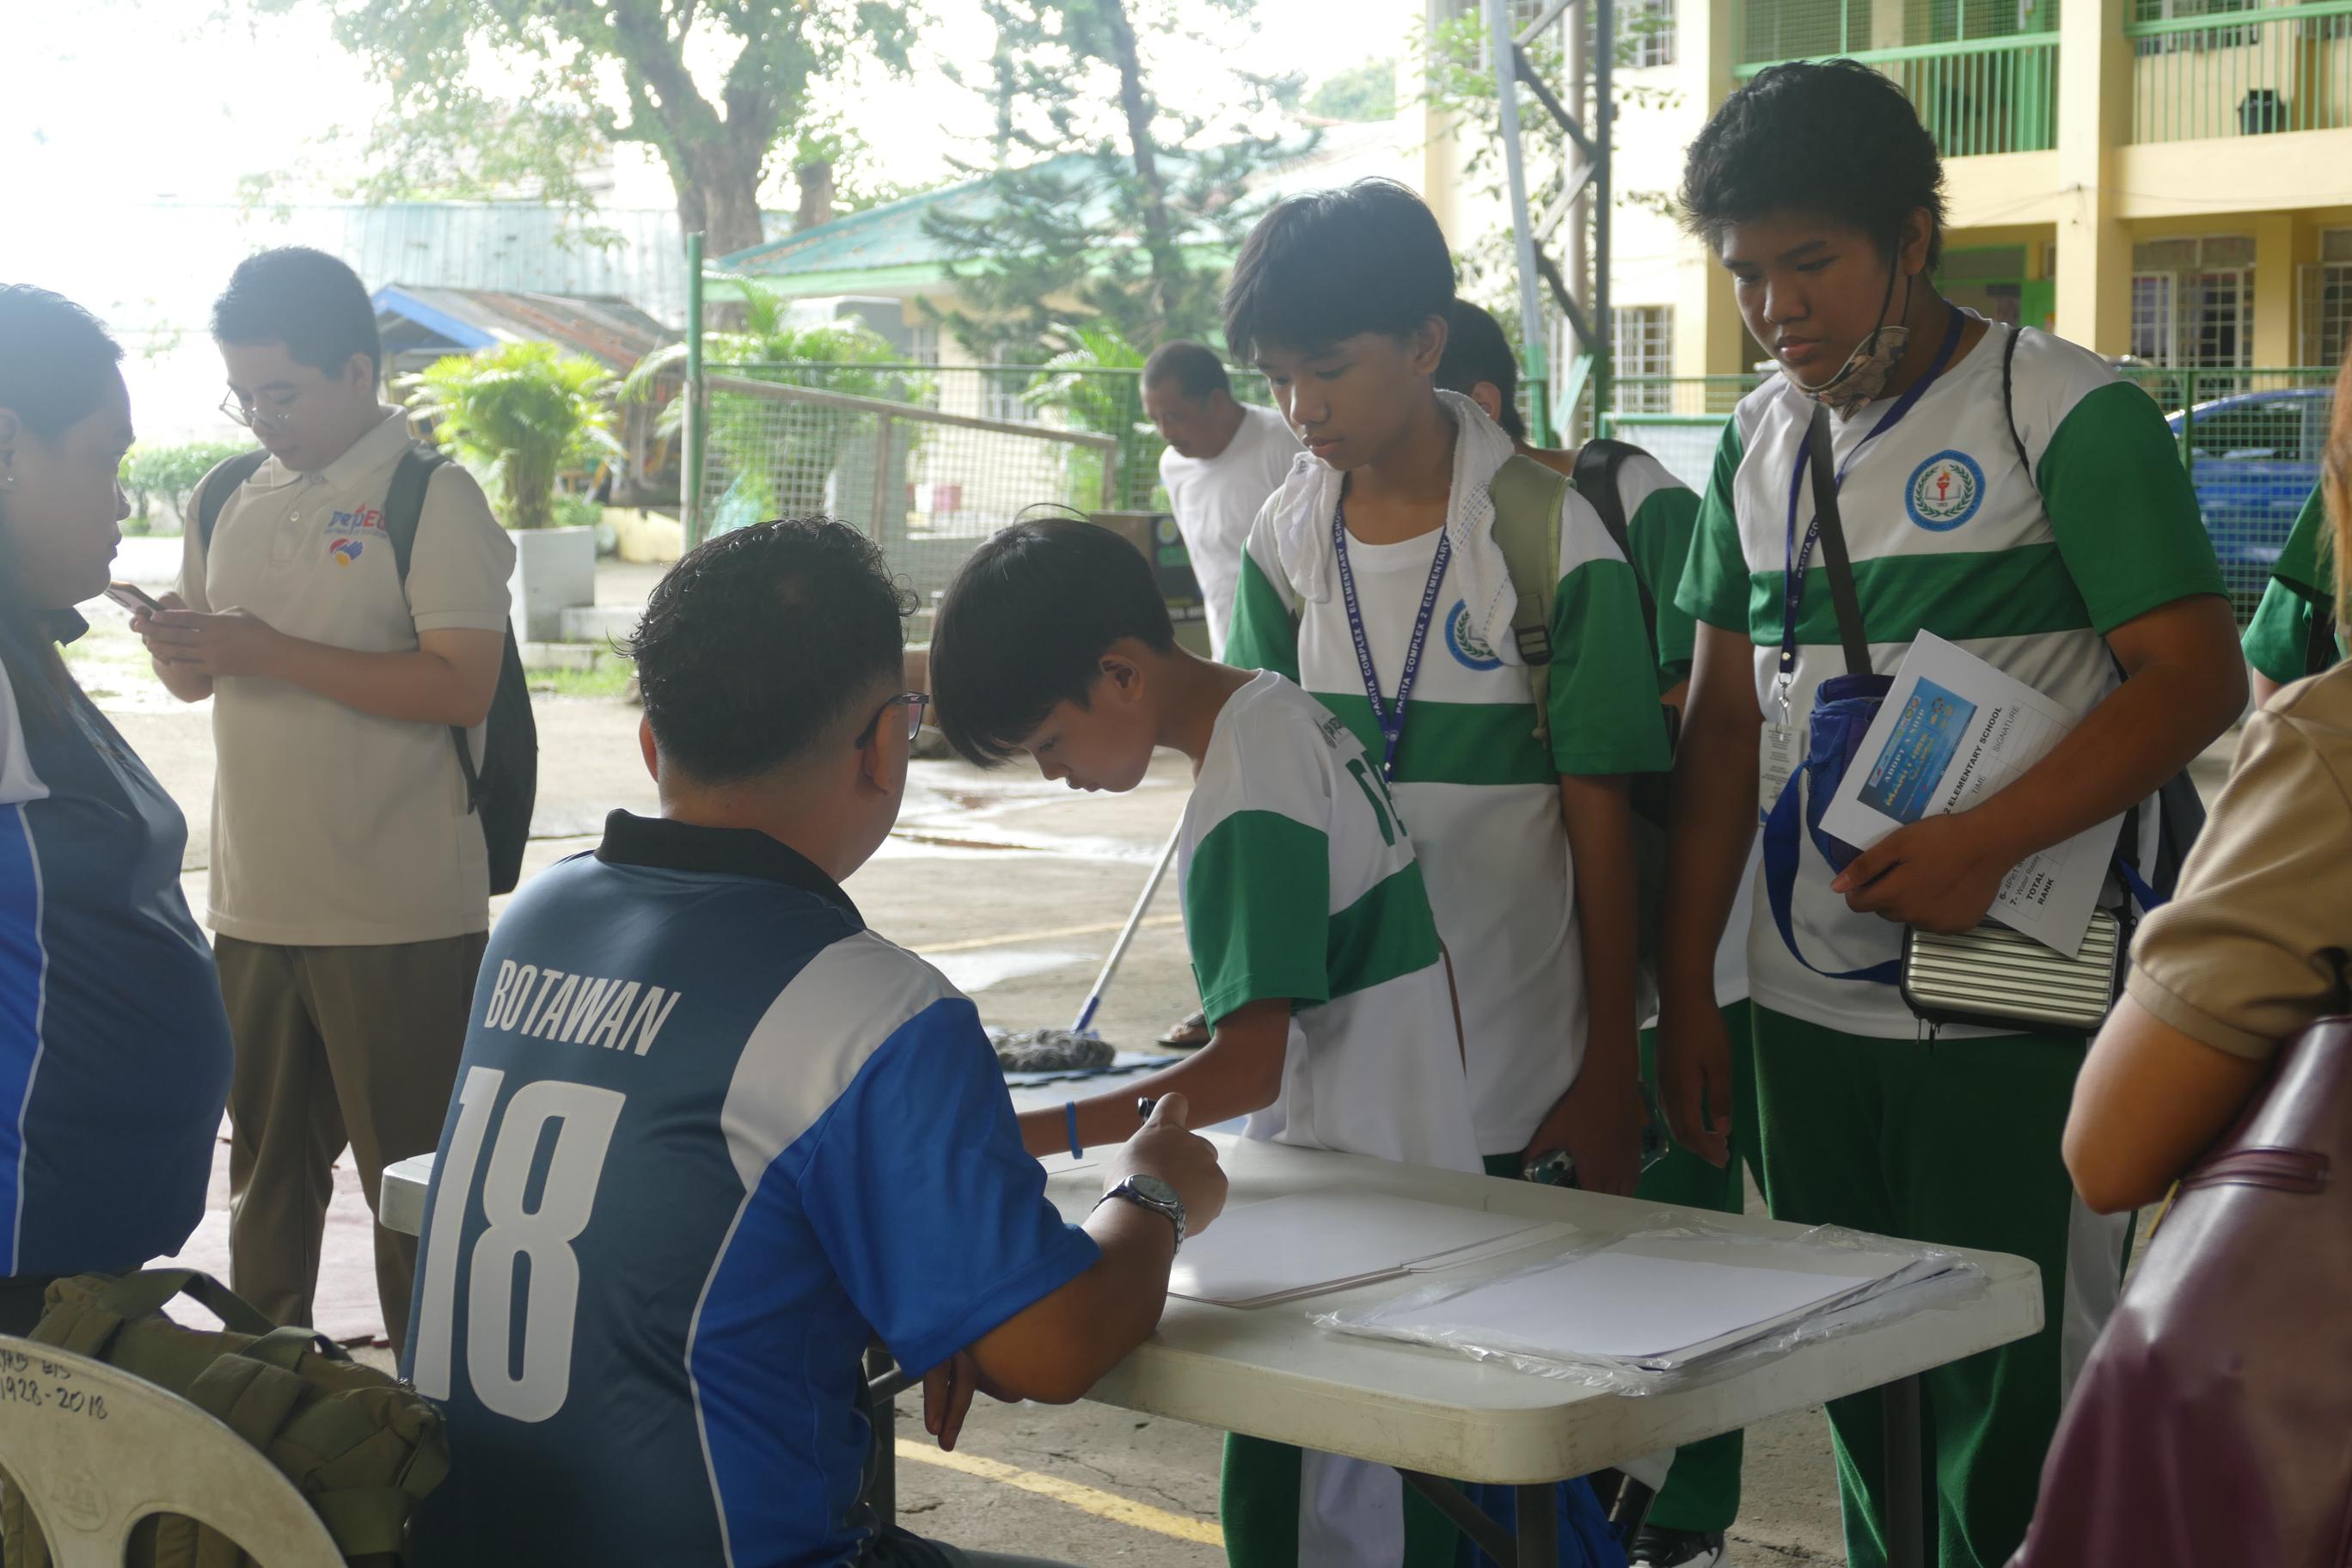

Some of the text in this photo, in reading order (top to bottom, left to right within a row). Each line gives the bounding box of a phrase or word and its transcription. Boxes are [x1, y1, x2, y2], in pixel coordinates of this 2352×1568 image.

[1338, 548, 1357, 614] ELEMENTARY
[1798, 542, 1812, 579] PACITA
[1353, 627, 1371, 677] COMPLEX
[1395, 677, 1412, 714] PACITA
[1406, 622, 1425, 672] COMPLEX
[1423, 538, 1450, 608] ELEMENTARY
[1367, 680, 1382, 716] PACITA
[1947, 744, 1983, 806] ELEMENTARY
[1980, 706, 2003, 745] SCHOOL
[1971, 703, 2021, 795] TIME SIGNATURE
[2015, 876, 2030, 896] Water
[2025, 854, 2043, 875] Relay
[2025, 872, 2046, 901] TOTAL
[2037, 877, 2055, 906] RANK
[484, 959, 682, 1057] BOTAWAN
[413, 1066, 626, 1423] 18
